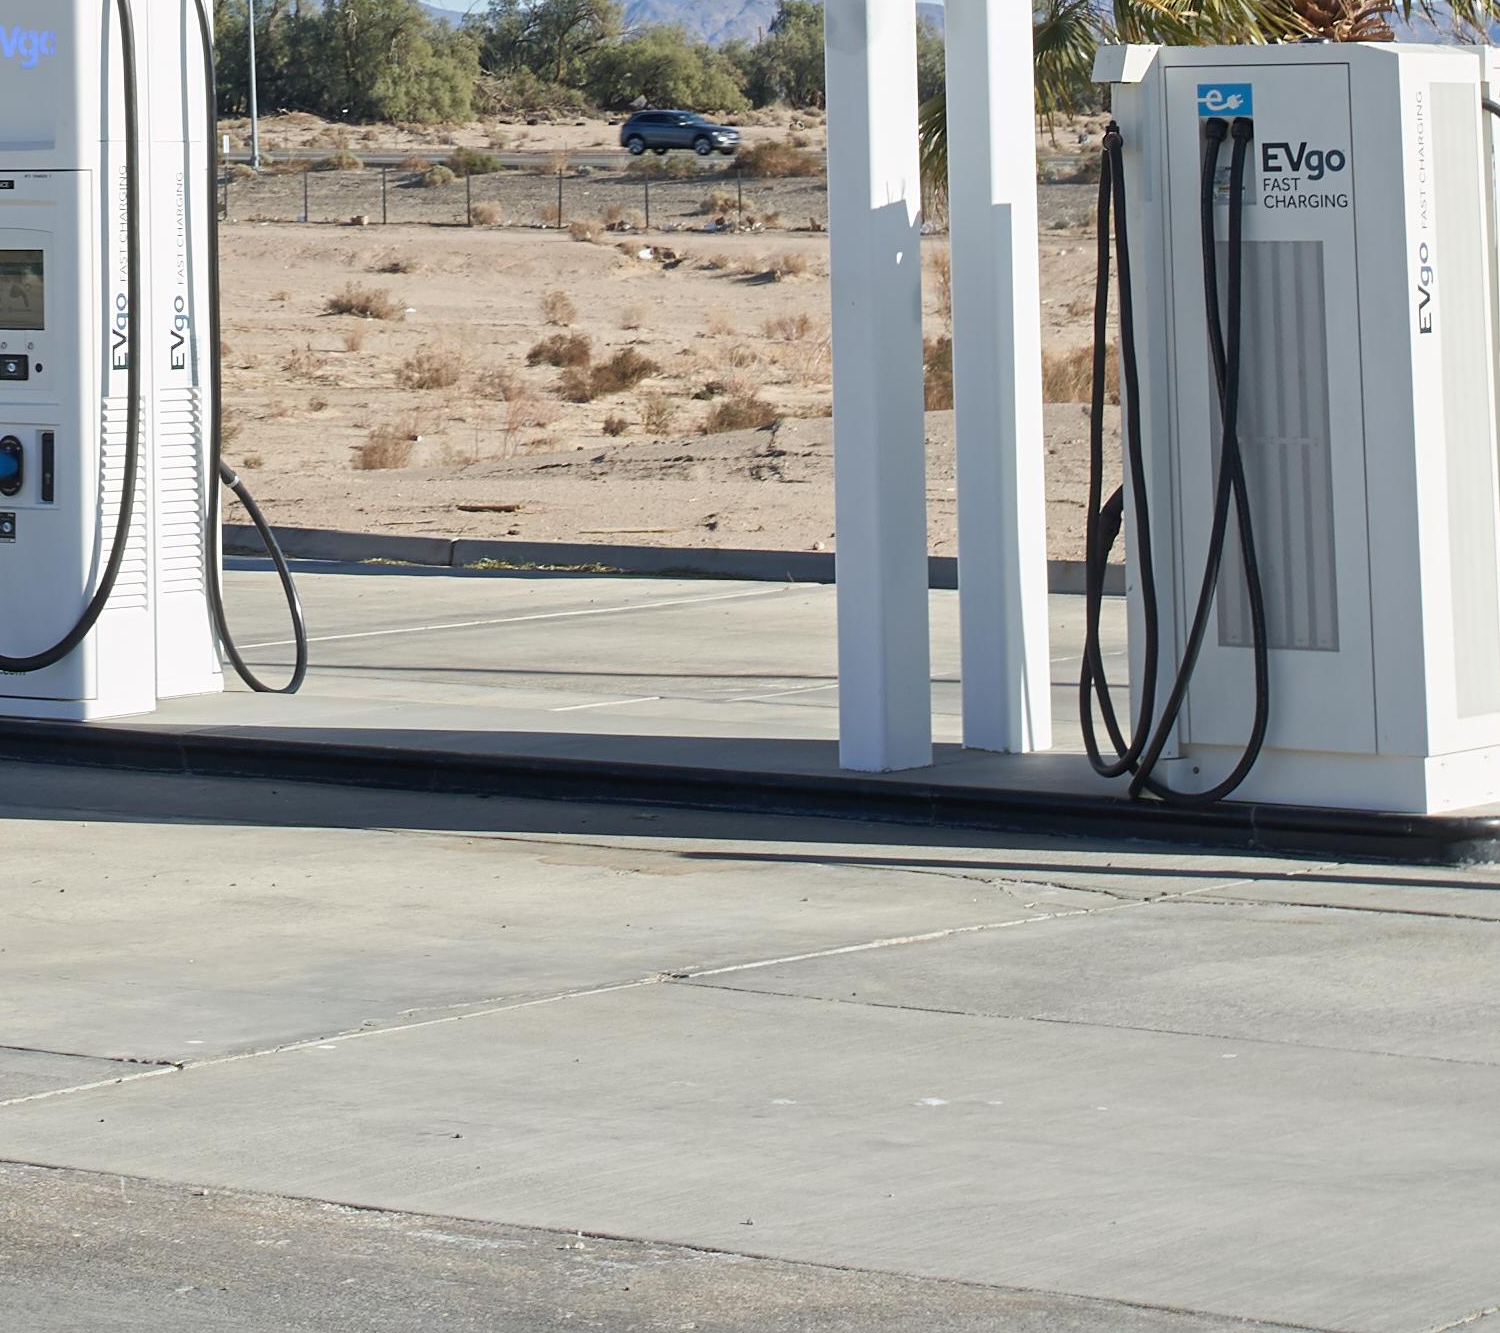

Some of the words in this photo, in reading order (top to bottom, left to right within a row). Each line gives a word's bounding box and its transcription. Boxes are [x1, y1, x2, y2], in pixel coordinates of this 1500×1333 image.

[1415, 91, 1425, 183] CHARGING
[1261, 142, 1346, 180] EVgo
[1263, 178, 1300, 191] FAST
[1264, 194, 1348, 208] CHARGING
[175, 172, 184, 248] CHARGING
[1419, 191, 1428, 229] FAST
[119, 250, 128, 282] FAST
[176, 254, 185, 285] FAST
[1418, 242, 1433, 334] EVgo
[170, 295, 190, 370] EVgo
